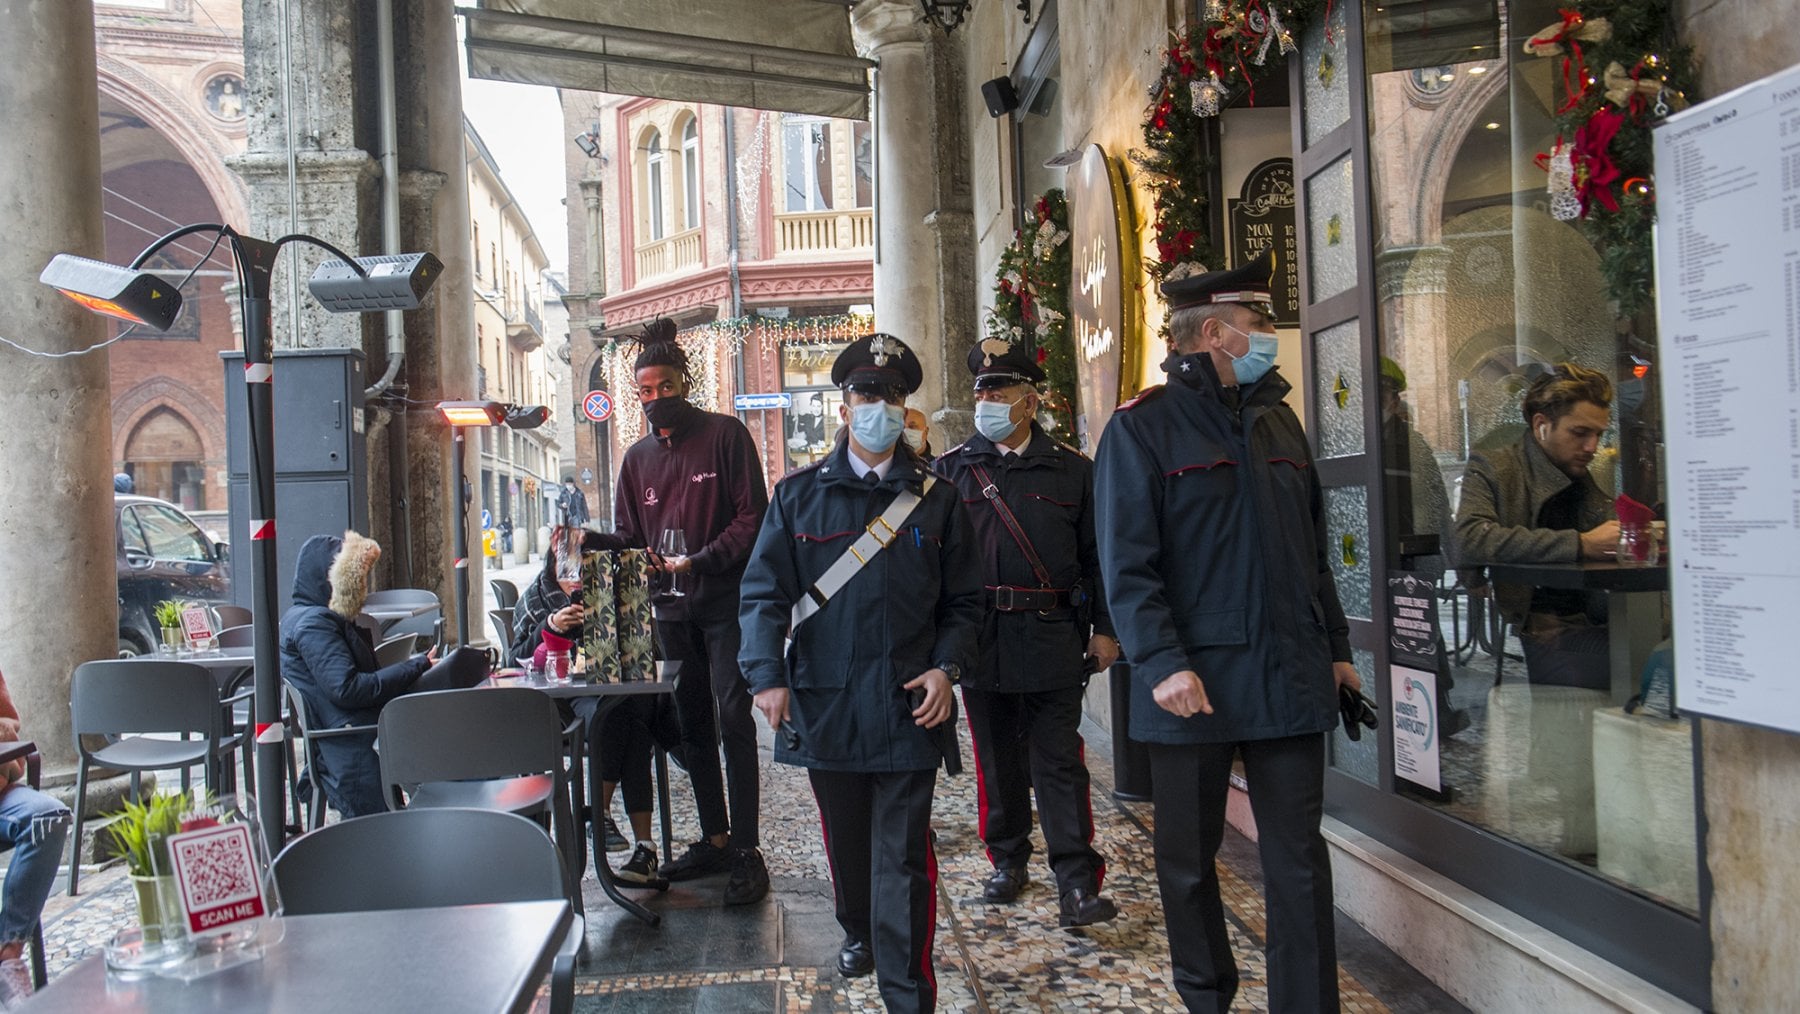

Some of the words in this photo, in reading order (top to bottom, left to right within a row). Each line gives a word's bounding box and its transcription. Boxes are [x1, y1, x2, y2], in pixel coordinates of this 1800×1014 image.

[1246, 223, 1273, 238] MON
[1285, 225, 1295, 236] 10
[1246, 238, 1273, 249] TUES
[1285, 238, 1295, 249] 10
[1244, 250, 1263, 262] WE
[1286, 251, 1296, 261] 10
[1081, 233, 1107, 309] Caffè
[1286, 263, 1296, 274] 10
[1287, 275, 1297, 286] 10
[1287, 288, 1298, 298] 10
[1288, 300, 1298, 311] 10
[178, 804, 226, 824] CAMPARI
[200, 910, 234, 928] SCAN
[235, 901, 255, 918] ME
